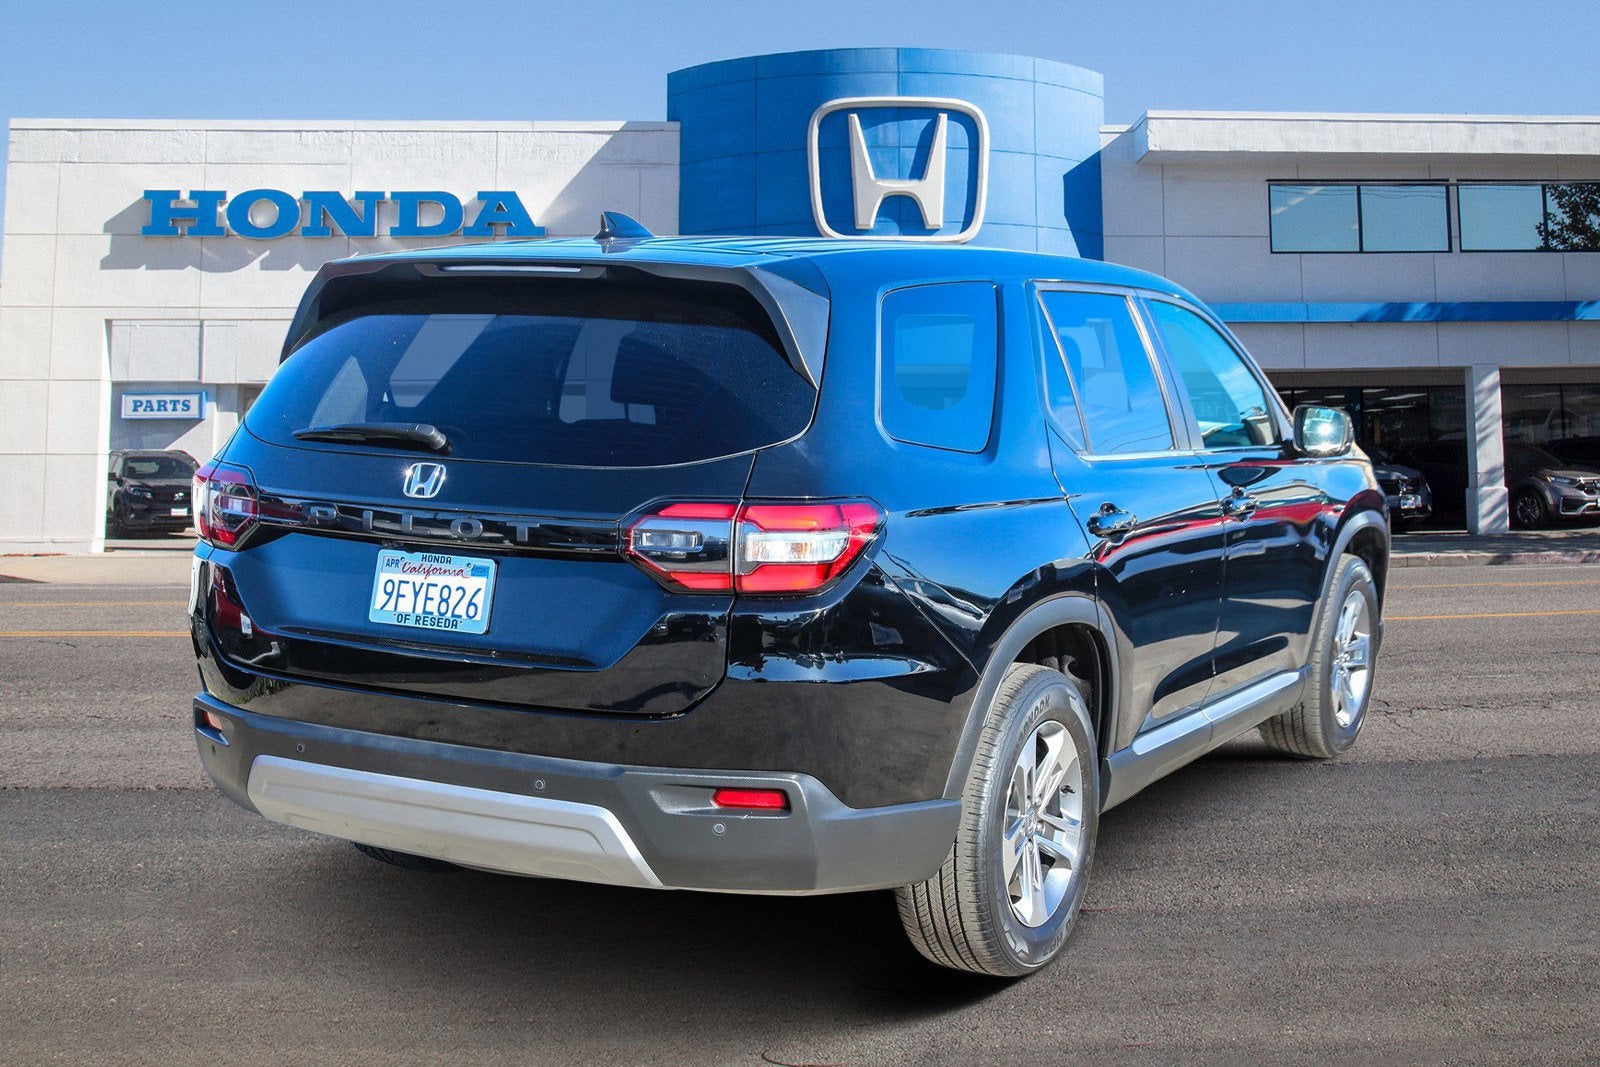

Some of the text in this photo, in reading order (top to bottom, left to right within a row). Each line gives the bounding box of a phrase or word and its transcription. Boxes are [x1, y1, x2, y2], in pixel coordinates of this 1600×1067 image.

[141, 189, 547, 240] HONDA
[132, 399, 191, 412] PARTS
[310, 505, 540, 542] PILOT
[385, 558, 400, 568] APR
[421, 554, 452, 564] HONDA
[401, 561, 471, 580] California
[380, 579, 482, 620] 9FYE826
[396, 613, 458, 629] OF RESEDA
